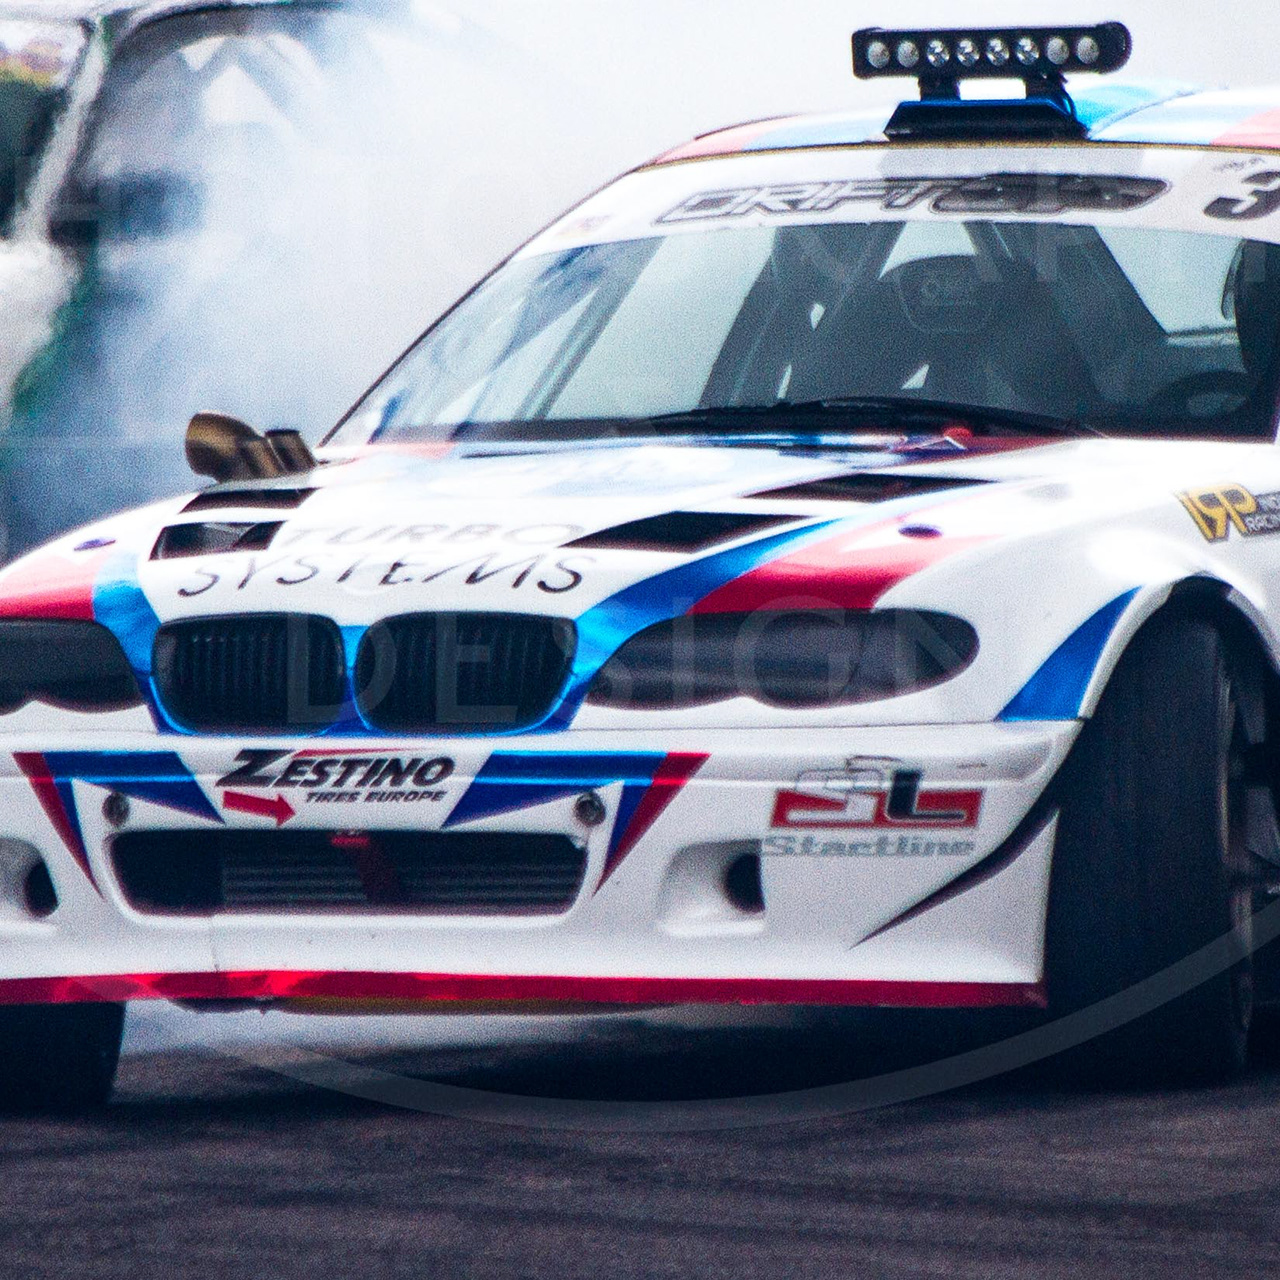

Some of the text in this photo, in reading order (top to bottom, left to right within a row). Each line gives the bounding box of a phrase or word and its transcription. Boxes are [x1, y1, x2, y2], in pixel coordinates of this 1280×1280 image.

[177, 552, 598, 599] SYSTEMS
[215, 749, 457, 788] ZESTINO
[364, 791, 448, 803] EUROPE
[764, 835, 976, 857] Startline
